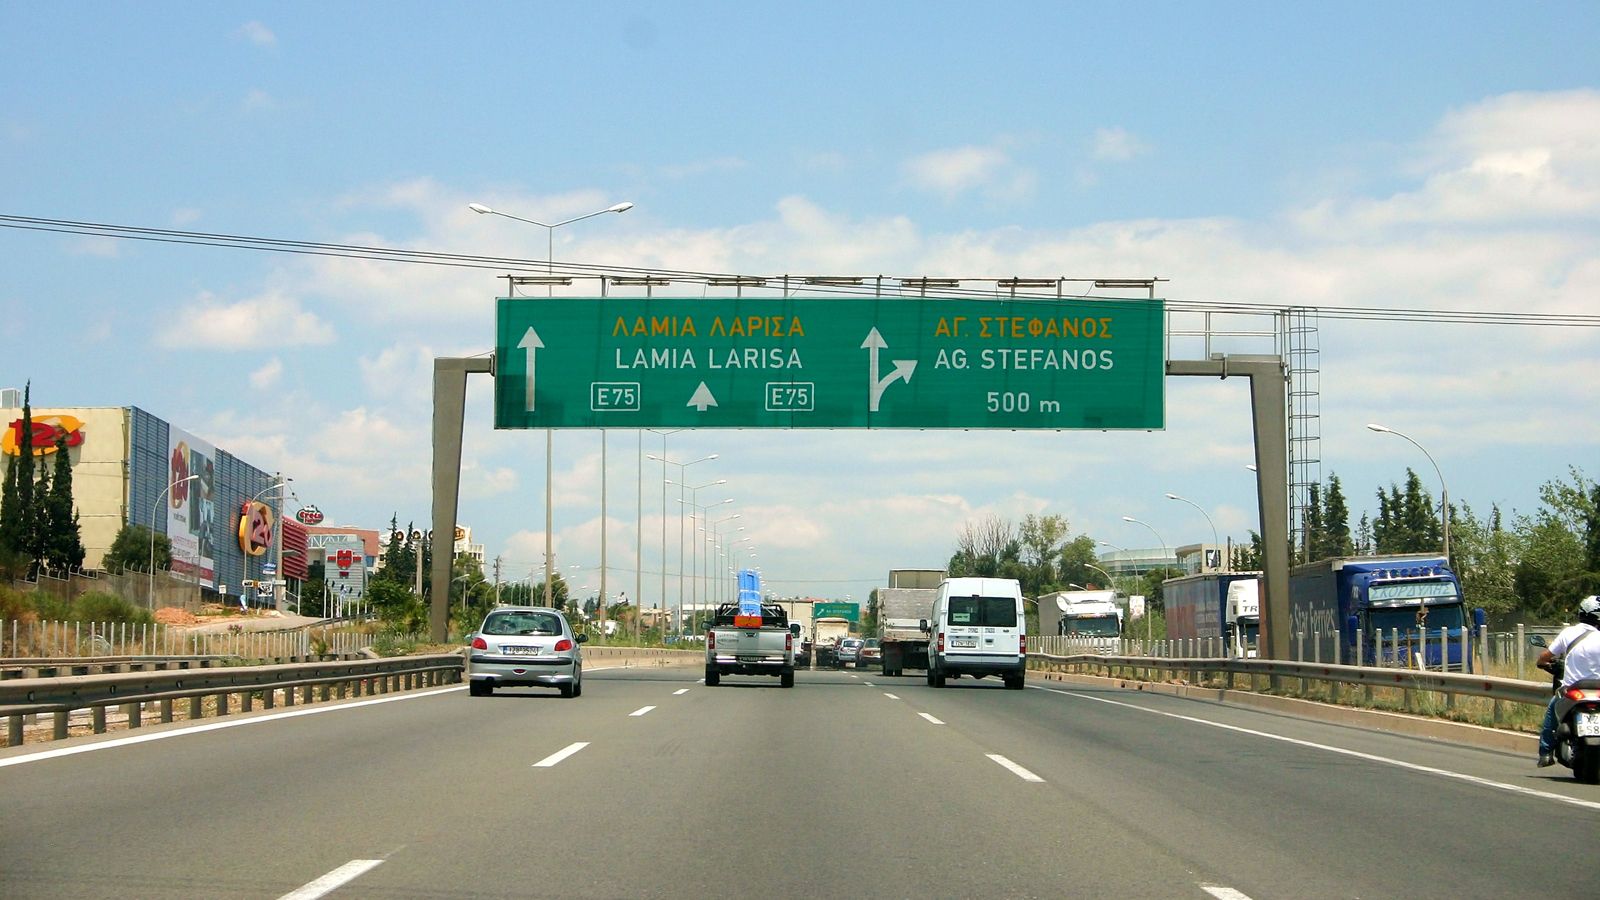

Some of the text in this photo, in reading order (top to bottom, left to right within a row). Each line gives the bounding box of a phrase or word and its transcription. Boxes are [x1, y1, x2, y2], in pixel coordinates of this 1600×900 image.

[612, 316, 805, 337] ΛΑΜΙΑ ΛΑΡΙΣΑ
[935, 317, 1112, 338] ΑΓ. ΣΤΕΦΑΝΟΣ
[617, 349, 802, 368] LAMIA LARISA
[935, 349, 1113, 369] AG. STEFANOS
[599, 388, 634, 405] E75
[773, 388, 807, 405] E75
[988, 392, 1060, 413] 500 m
